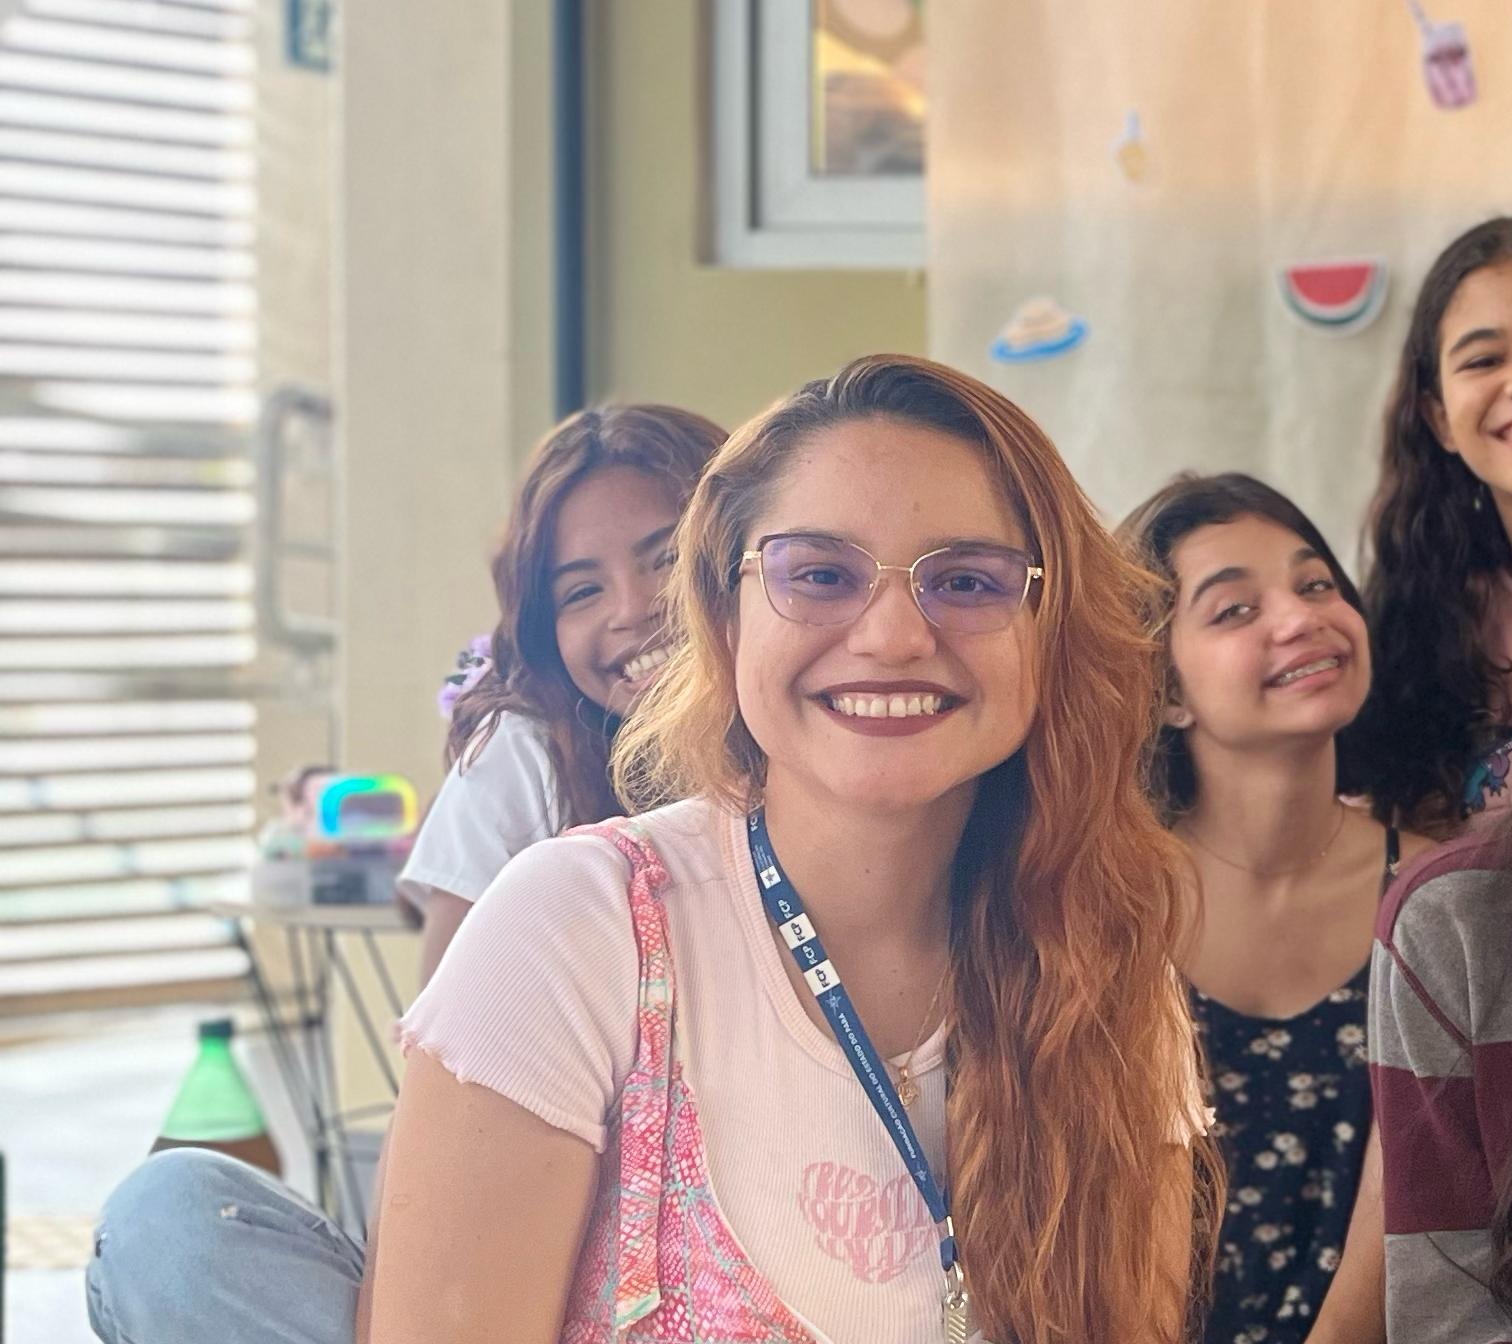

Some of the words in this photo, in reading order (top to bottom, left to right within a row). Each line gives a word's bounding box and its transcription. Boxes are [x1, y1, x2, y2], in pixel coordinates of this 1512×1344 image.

[778, 899, 794, 919] FCP
[791, 922, 806, 942] FCP
[802, 945, 818, 965] FCP
[815, 968, 830, 988] FCP
